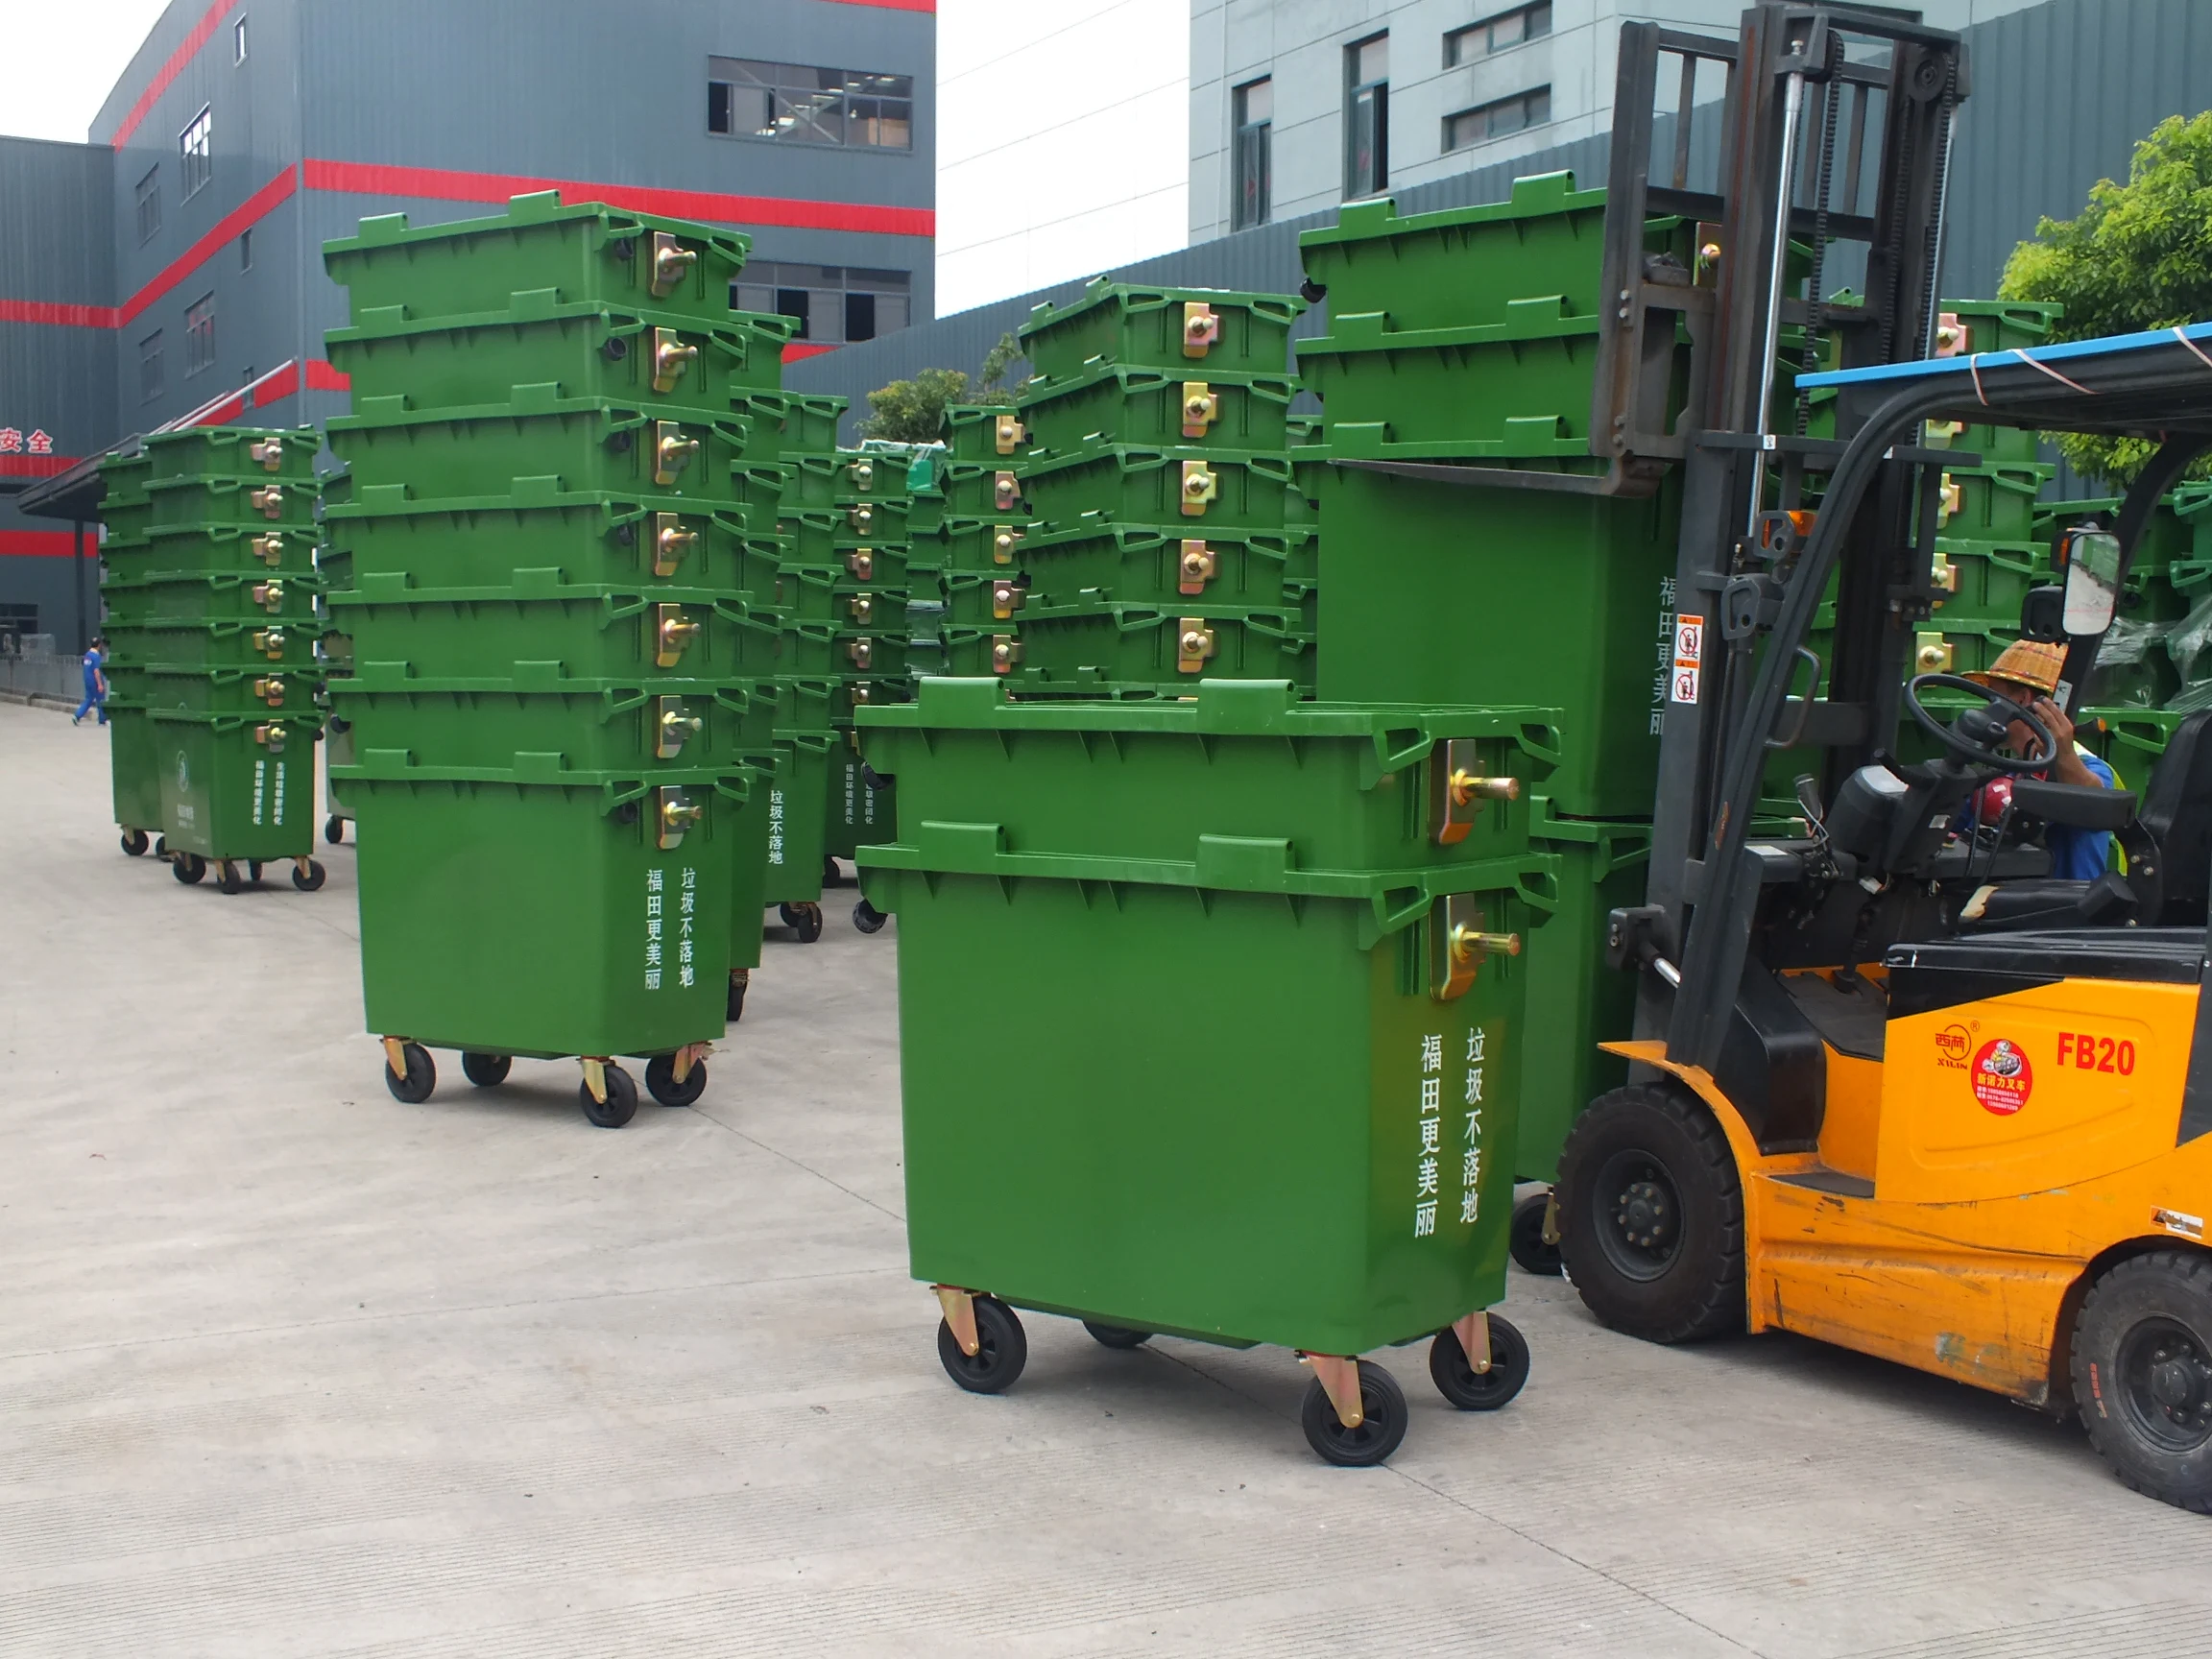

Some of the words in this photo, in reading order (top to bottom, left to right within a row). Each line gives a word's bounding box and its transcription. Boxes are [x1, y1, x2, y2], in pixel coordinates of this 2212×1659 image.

[0, 427, 53, 453] 安全
[768, 790, 783, 865] 垃圾不落地
[644, 868, 663, 991] 福田更美丽
[679, 867, 696, 989] 垃圾不落地
[1937, 1058, 1968, 1070] XILIN
[2056, 1031, 2136, 1076] FB20
[1414, 1033, 1443, 1238] 福田更美丽
[1459, 1026, 1486, 1224] 垃圾不落地
